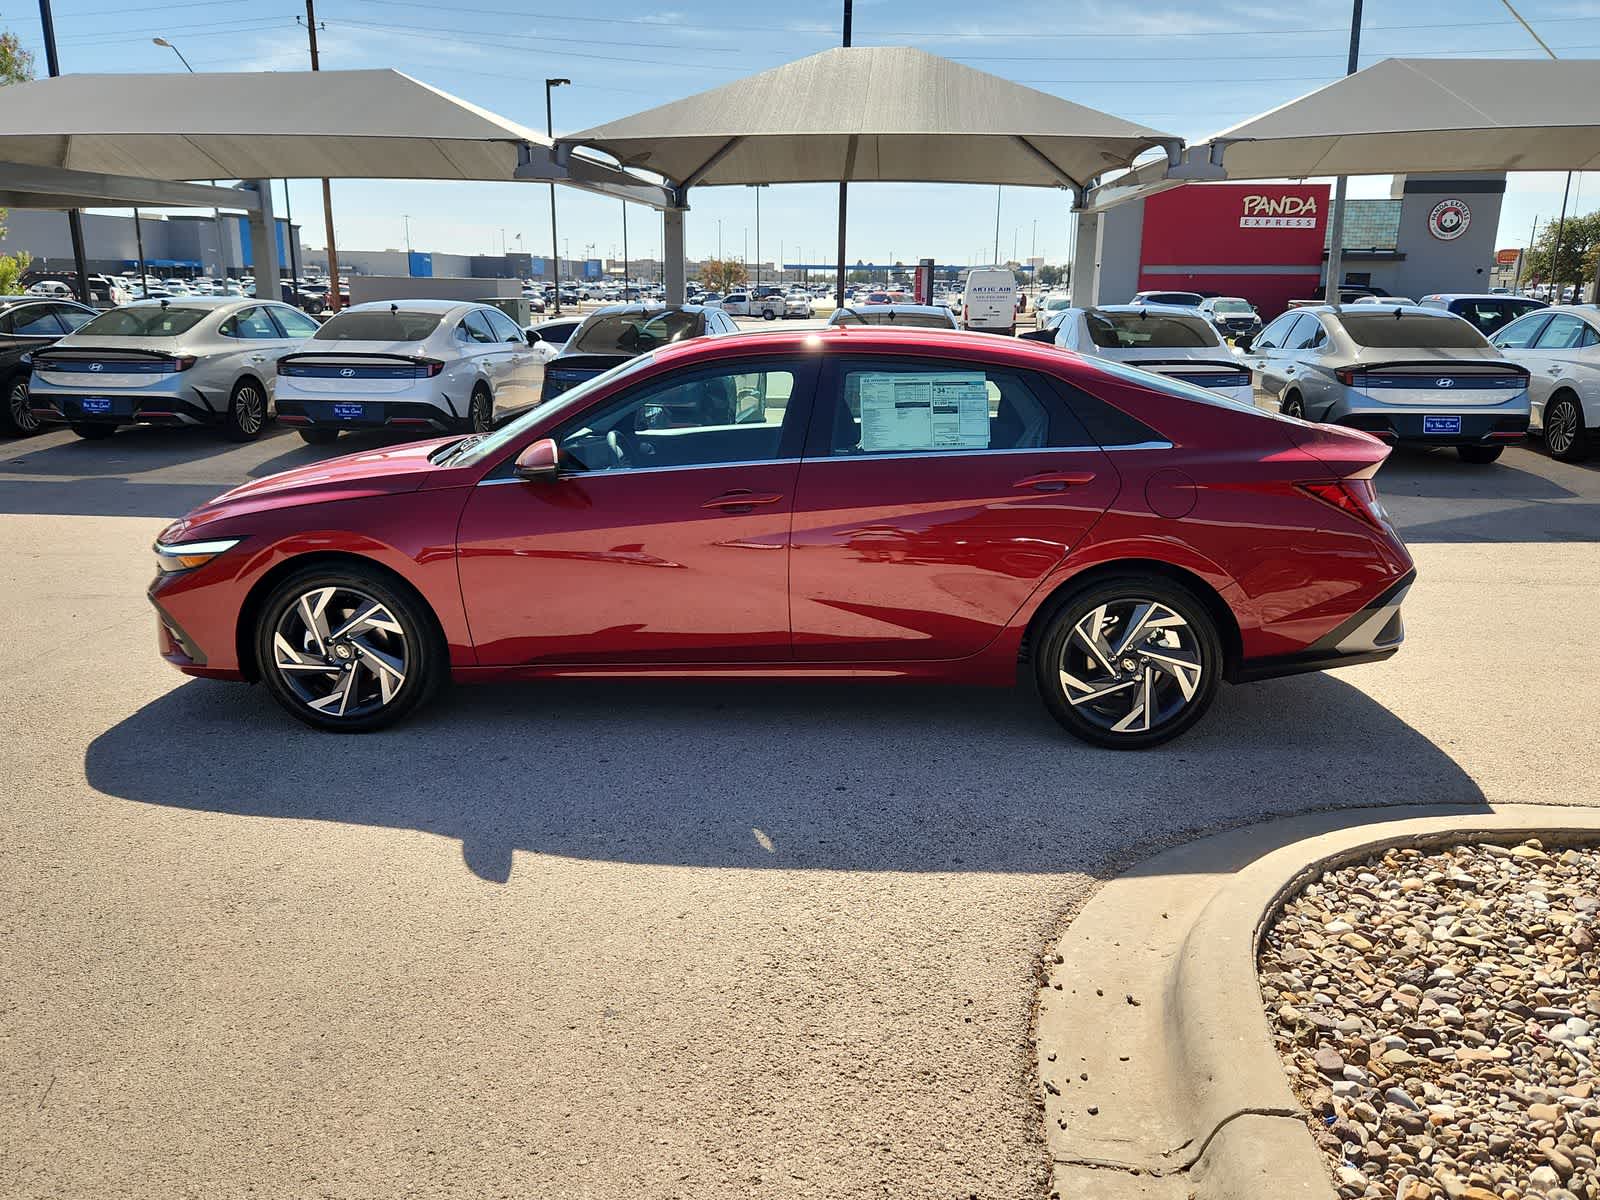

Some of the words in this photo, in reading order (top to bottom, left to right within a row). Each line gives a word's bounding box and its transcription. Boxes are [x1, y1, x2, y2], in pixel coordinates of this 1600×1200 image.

[1243, 195, 1317, 216] PANDA
[1431, 202, 1449, 221] PANDA
[1450, 200, 1470, 221] EXPRESS
[1244, 218, 1312, 227] EXPRESS
